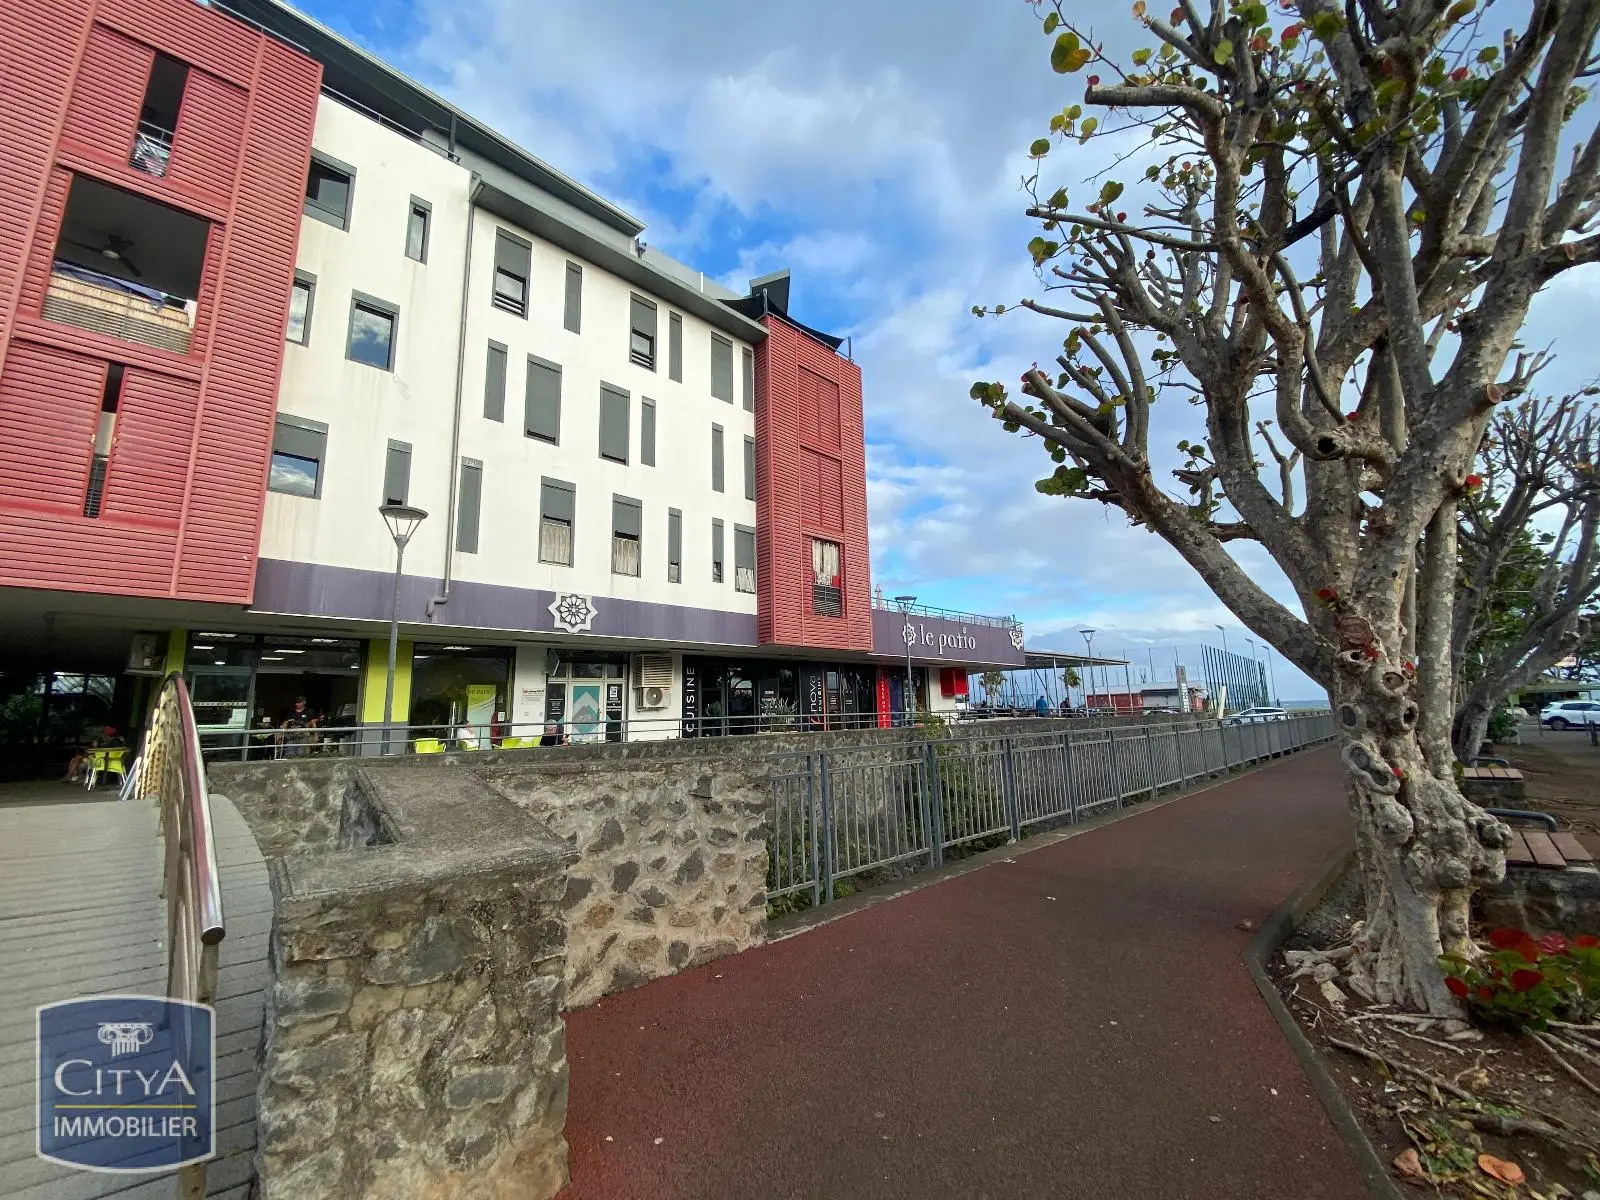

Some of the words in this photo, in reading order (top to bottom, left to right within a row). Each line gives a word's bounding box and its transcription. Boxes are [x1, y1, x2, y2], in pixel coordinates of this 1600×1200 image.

[920, 624, 934, 646] le
[939, 627, 976, 654] patio
[685, 667, 696, 732] CUISINE
